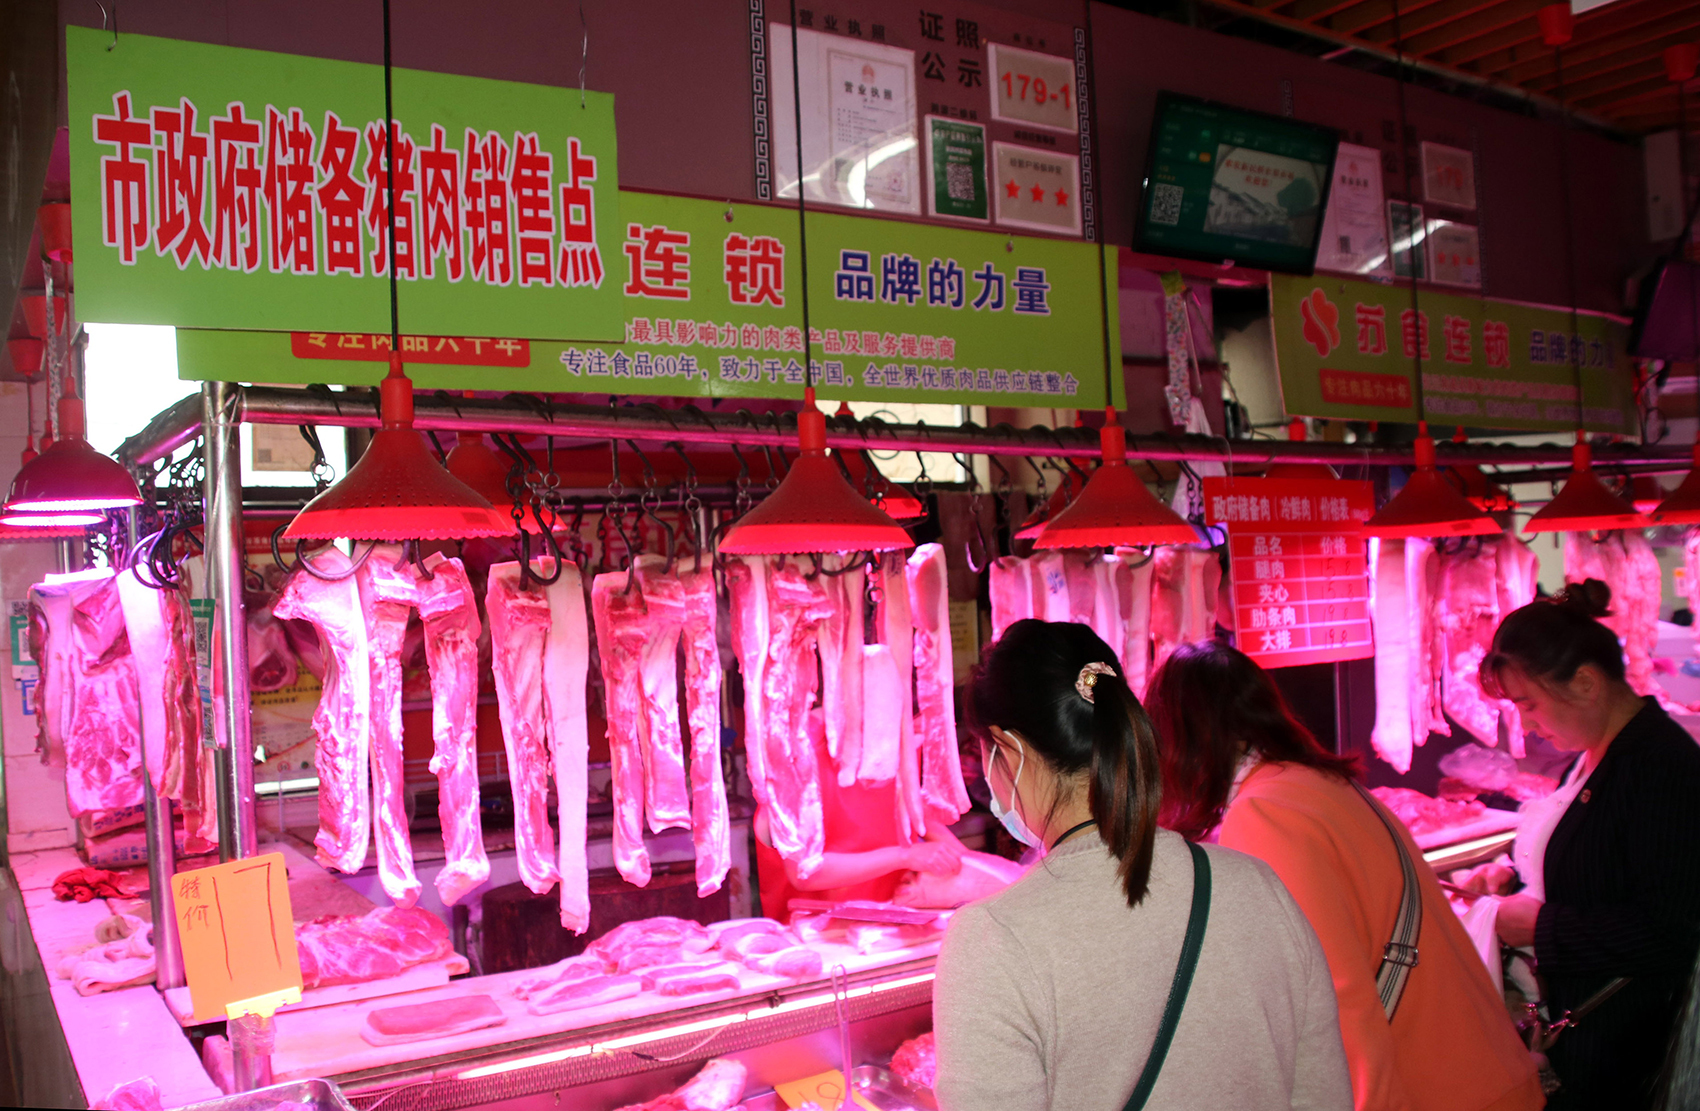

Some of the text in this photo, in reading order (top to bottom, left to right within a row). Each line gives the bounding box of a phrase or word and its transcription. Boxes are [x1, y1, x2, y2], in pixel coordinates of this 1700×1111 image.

[799, 9, 886, 41] 营业执照
[919, 10, 981, 50] 证照
[921, 52, 983, 88] 公示
[1001, 71, 1071, 110] 179-1
[93, 91, 604, 288] 市政府储备猪肉销售点
[624, 225, 1052, 316] 连锁 品牌的力量
[1354, 302, 1512, 369] 苏食连锁
[1253, 536, 1347, 556] 品名 价格
[1255, 560, 1285, 579] 腿肉
[1258, 584, 1289, 603] 夹心
[1252, 605, 1296, 627] 肋条肉
[1261, 630, 1292, 651] 大排
[179, 876, 210, 932] 特价
